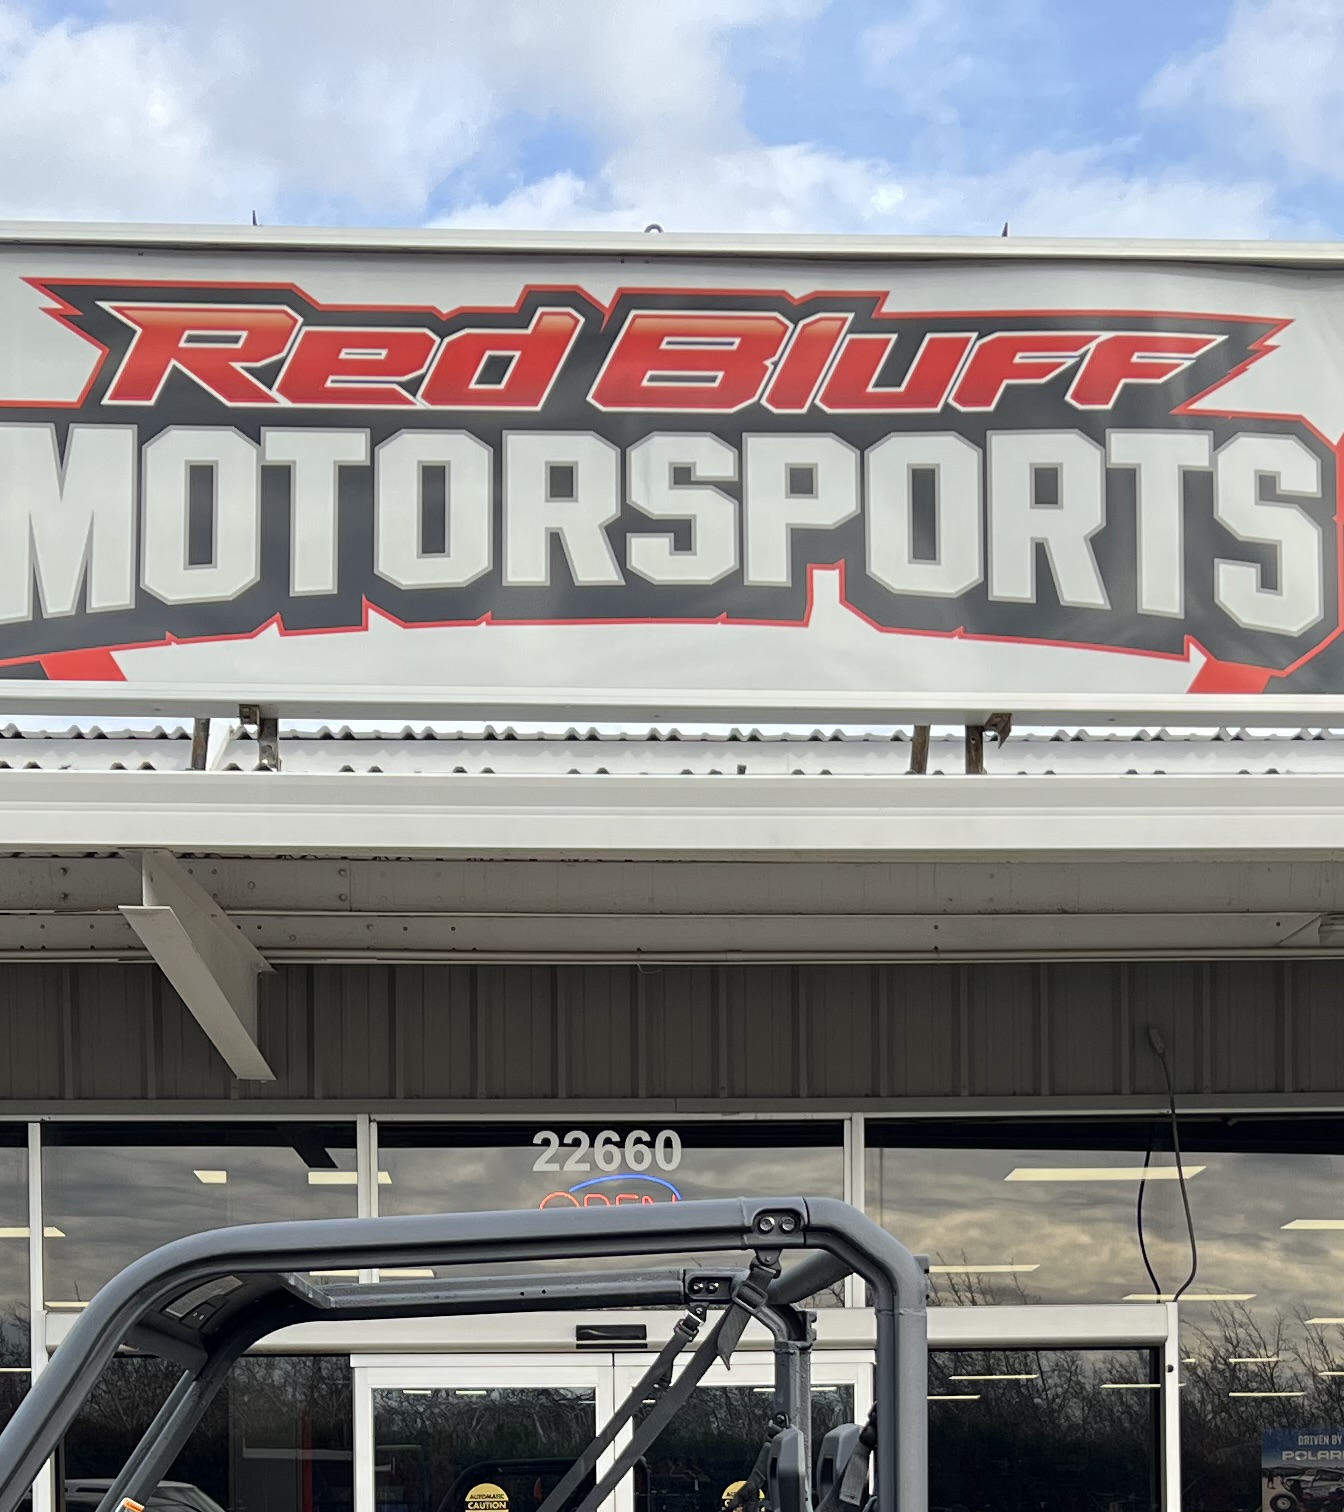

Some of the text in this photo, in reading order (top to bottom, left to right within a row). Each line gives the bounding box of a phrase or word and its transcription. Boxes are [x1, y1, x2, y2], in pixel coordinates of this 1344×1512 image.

[96, 301, 1229, 413] Red Bluff
[532, 1130, 682, 1172] 22660
[1298, 1434, 1343, 1445] DRIVEN BY
[467, 1501, 507, 1510] CAUTION
